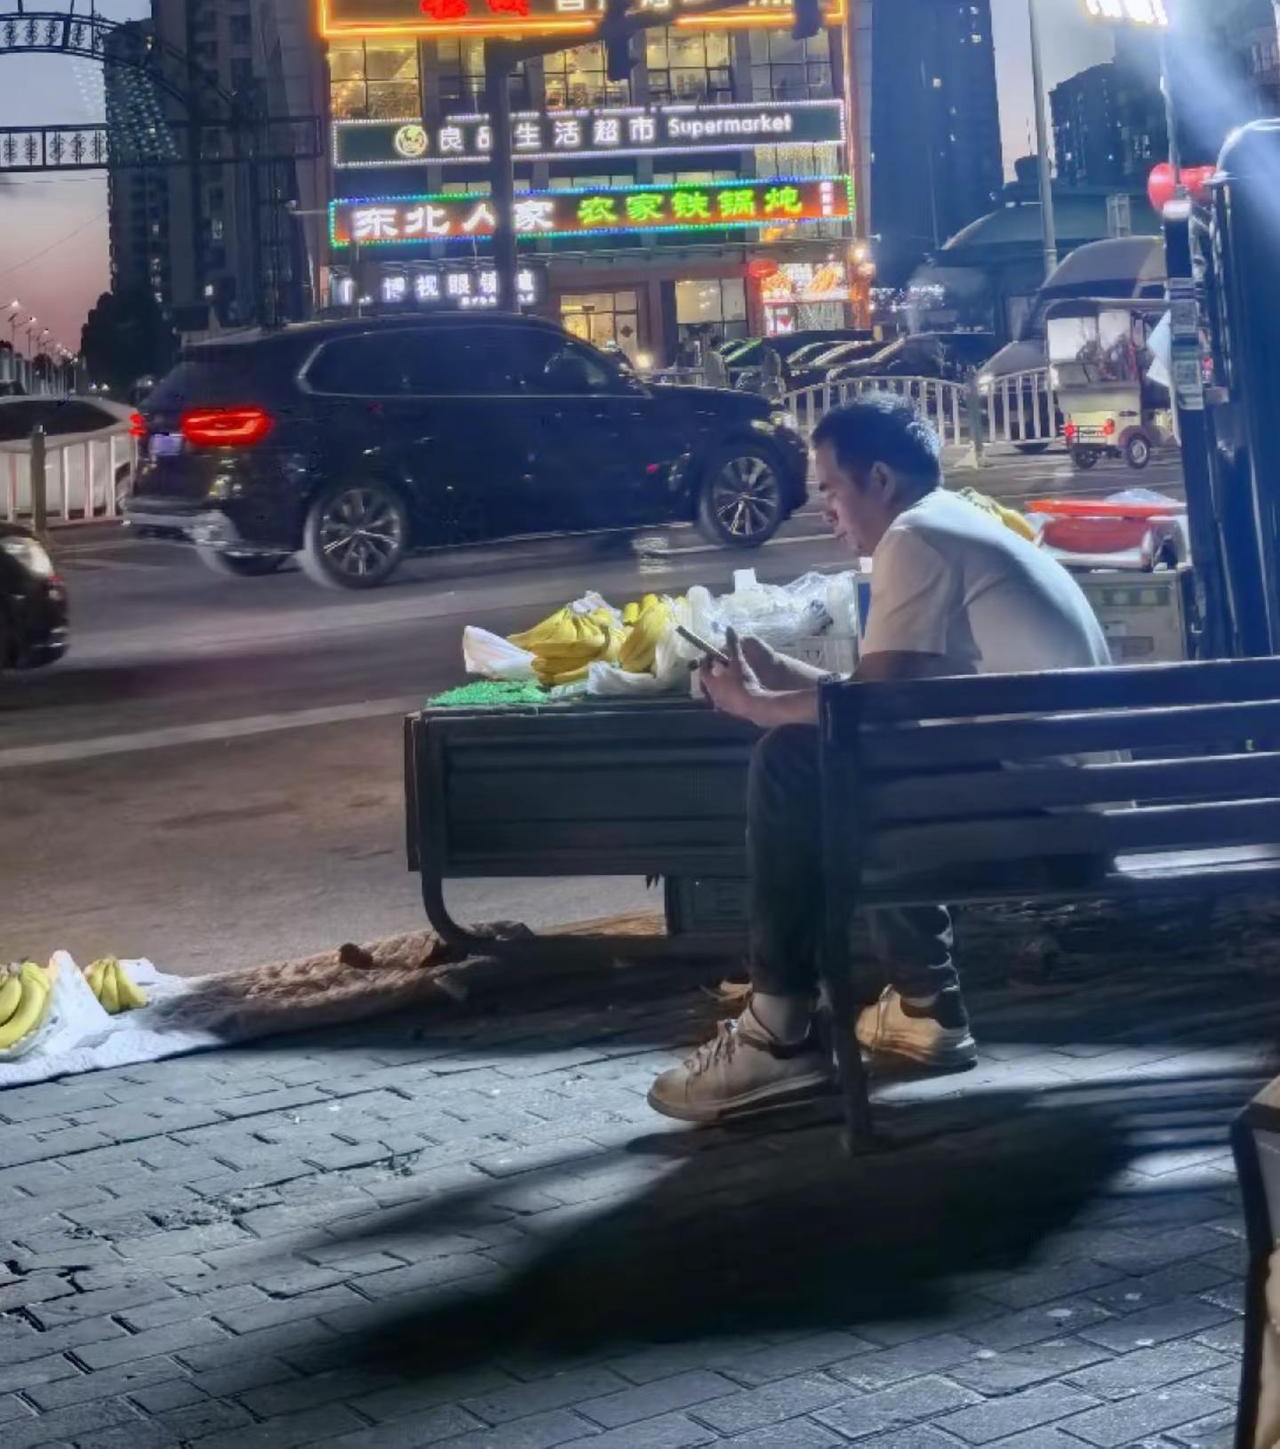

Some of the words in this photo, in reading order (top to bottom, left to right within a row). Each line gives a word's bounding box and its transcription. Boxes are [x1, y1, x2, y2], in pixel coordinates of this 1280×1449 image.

[667, 114, 793, 140] Supermarket
[352, 199, 554, 238] 东北人家
[577, 186, 803, 225] 农家铁锅炖
